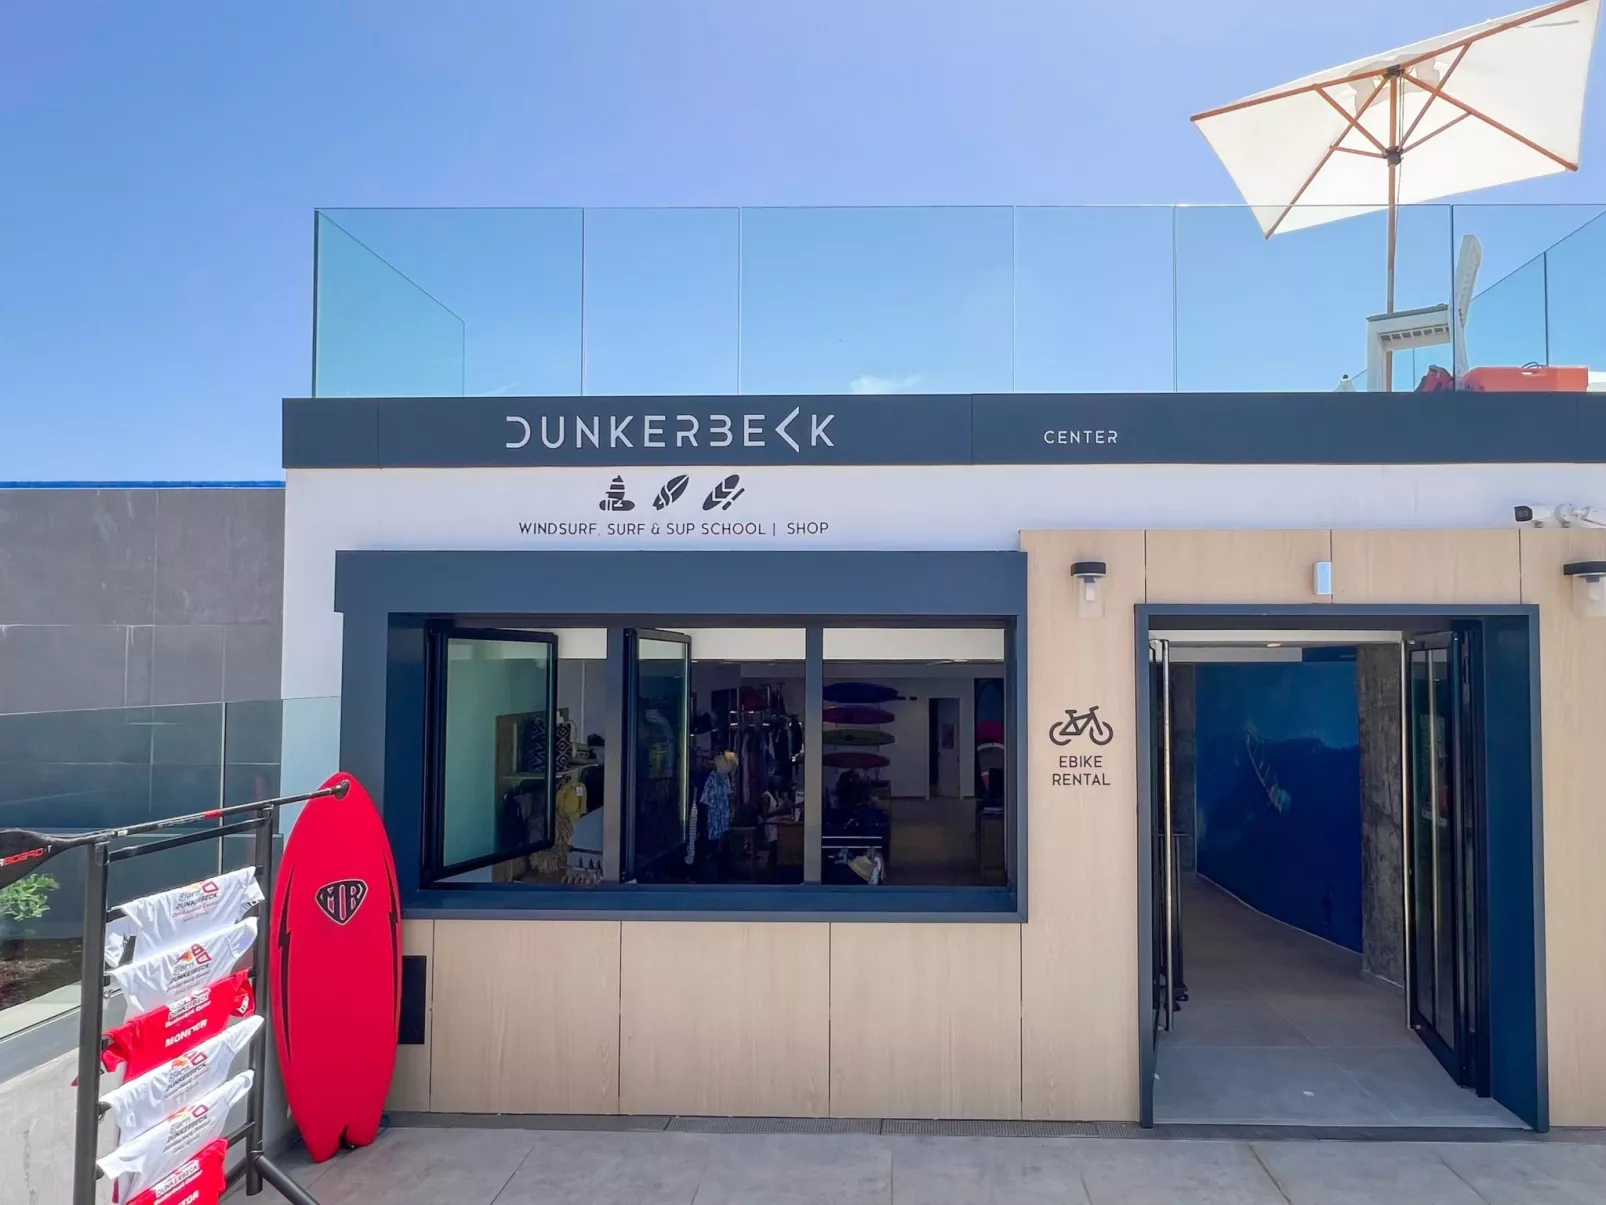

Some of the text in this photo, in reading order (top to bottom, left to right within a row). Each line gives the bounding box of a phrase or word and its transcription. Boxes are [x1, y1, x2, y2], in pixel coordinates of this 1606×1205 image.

[506, 406, 834, 453] DUNKERBECK
[1043, 430, 1118, 445] CENTER
[607, 522, 646, 536] SURF
[650, 522, 661, 535] &
[666, 522, 696, 536] SUP
[701, 522, 767, 536] SCHOOL
[787, 521, 830, 536] SHOP
[1059, 755, 1103, 769] EBIKE
[1052, 772, 1111, 786] RENTAL
